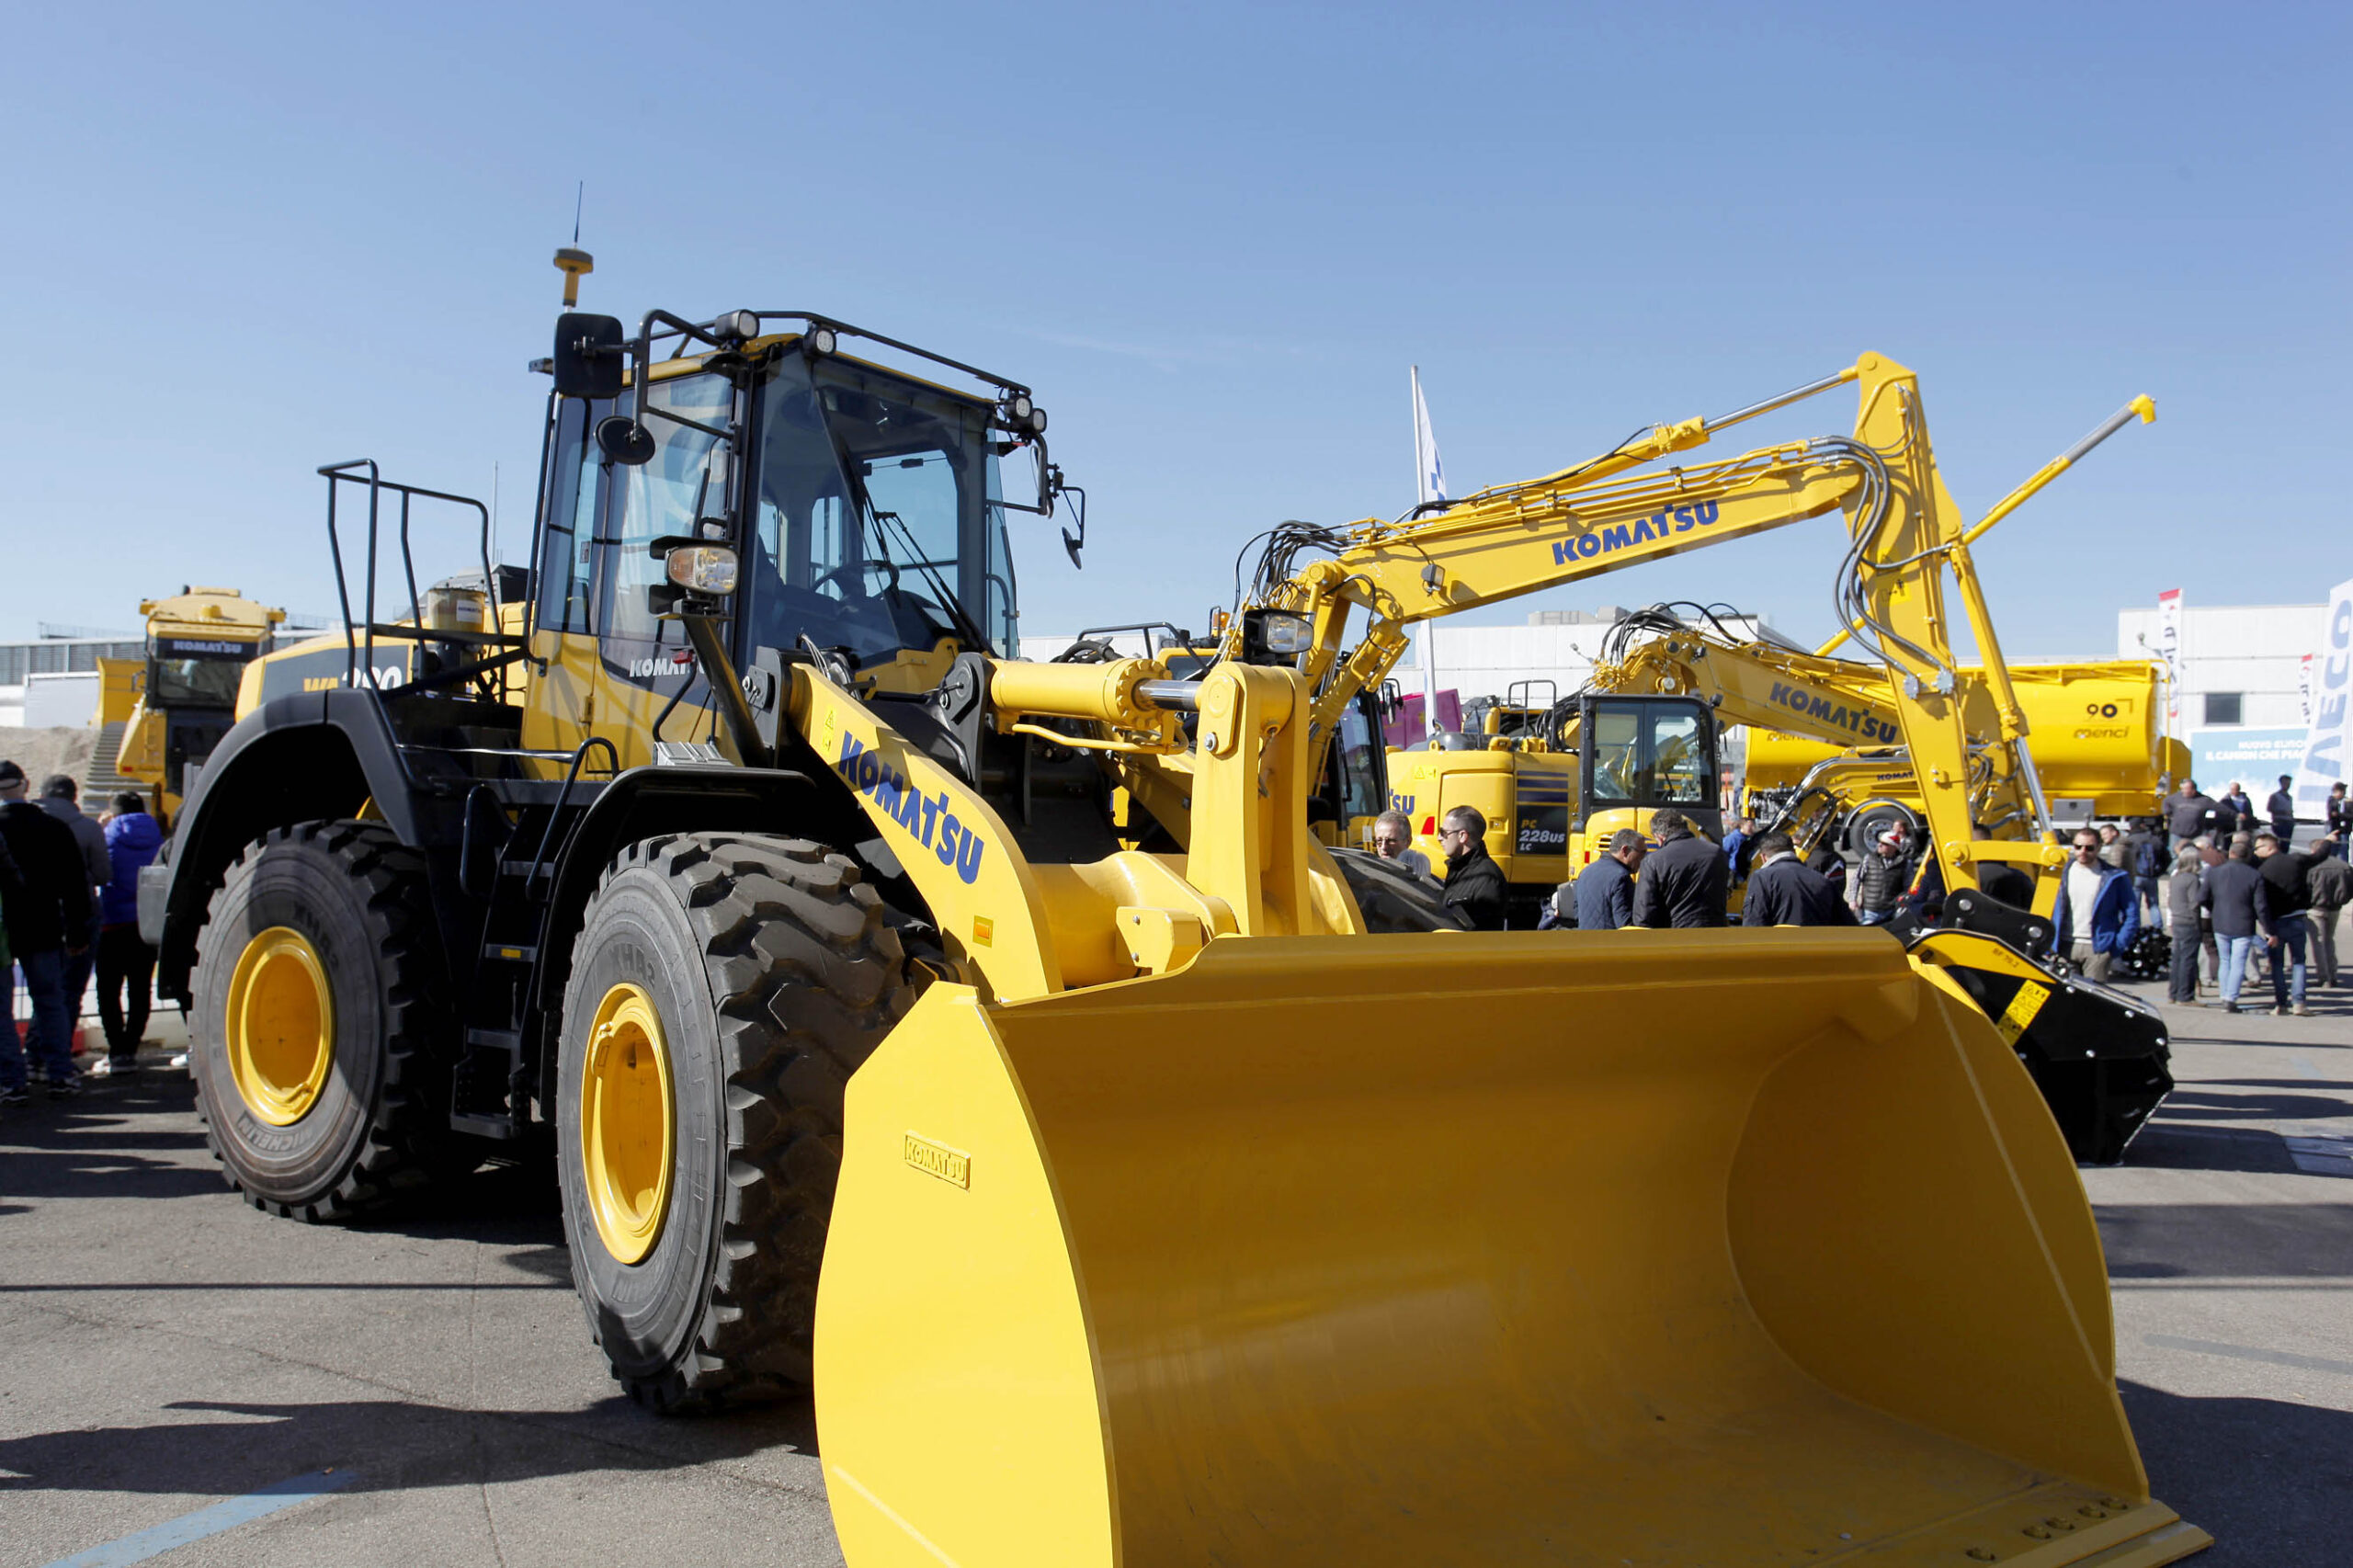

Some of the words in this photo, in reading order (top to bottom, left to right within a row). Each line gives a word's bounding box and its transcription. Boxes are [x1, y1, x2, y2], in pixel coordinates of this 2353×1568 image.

[1552, 499, 1720, 566] KOMATSU
[173, 640, 243, 653] KOMATSU
[1769, 681, 1898, 744] KOMATSU
[838, 730, 984, 884] KOMATSU
[1521, 819, 1537, 829] PC
[1520, 843, 1532, 851] LC
[238, 1116, 315, 1152] MICHELIN
[905, 1140, 966, 1182] KOMATSU
